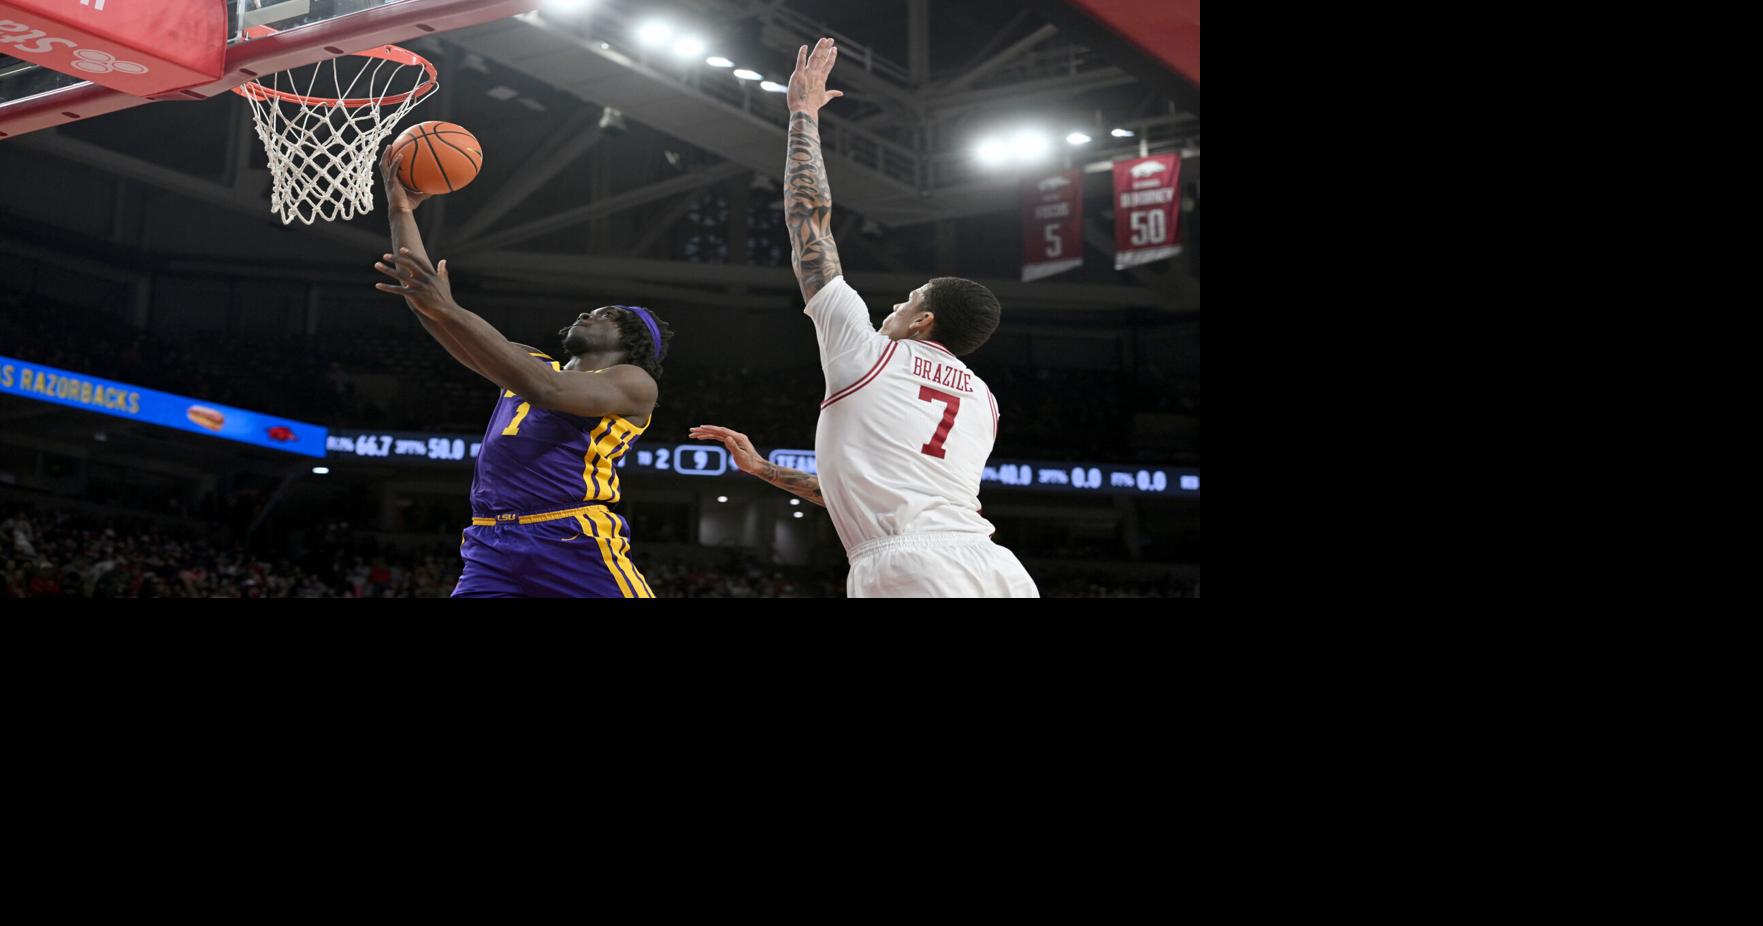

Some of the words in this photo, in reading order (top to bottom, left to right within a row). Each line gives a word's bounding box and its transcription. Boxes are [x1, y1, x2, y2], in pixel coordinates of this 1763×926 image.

[1044, 223, 1062, 258] 5
[1130, 208, 1166, 246] 50
[20, 368, 141, 414] RAZORBACKS
[913, 356, 974, 393] BRAZILE
[501, 402, 531, 436] 1
[918, 385, 961, 460] 7
[355, 435, 393, 457] 66.7
[428, 438, 465, 459] 50.0
[655, 448, 670, 470] 2
[693, 451, 708, 470] 9
[1071, 467, 1102, 489] 0.0
[1136, 470, 1166, 492] 0.0
[493, 513, 516, 522] LSU
